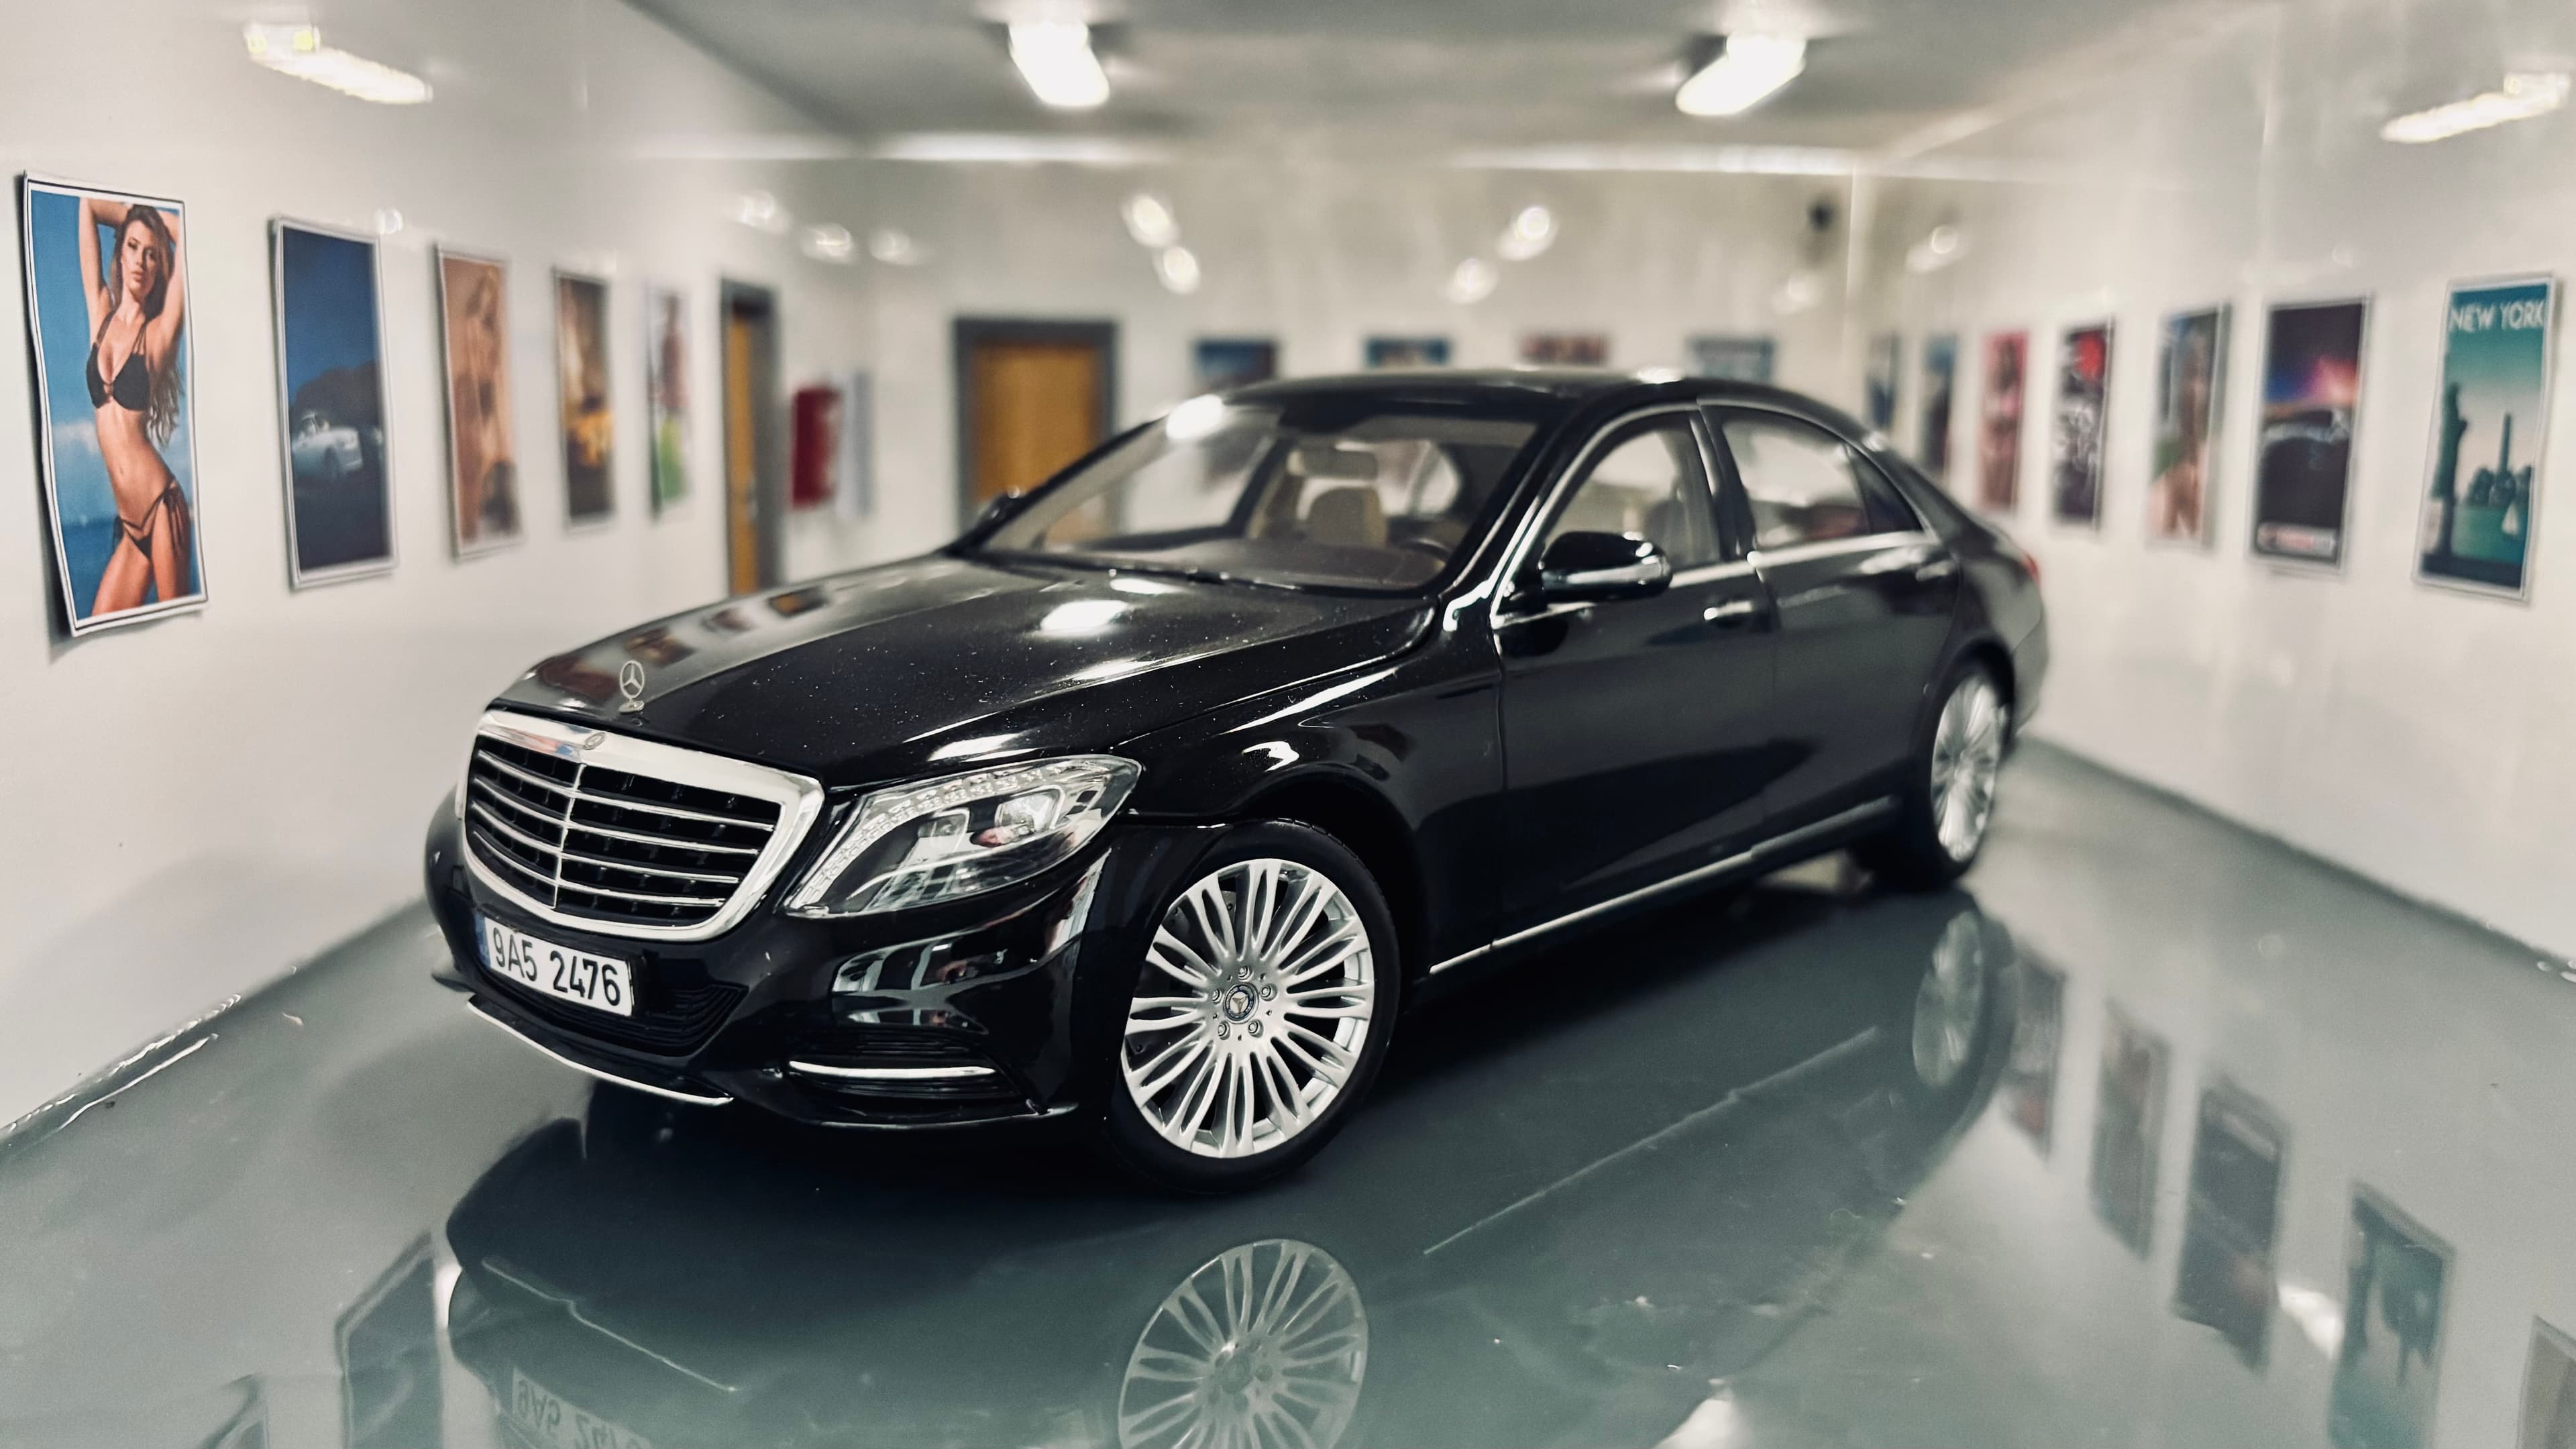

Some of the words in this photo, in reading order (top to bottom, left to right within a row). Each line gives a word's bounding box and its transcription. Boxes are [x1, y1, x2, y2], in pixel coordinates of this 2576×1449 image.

[2449, 303, 2496, 333] NEW
[2500, 299, 2544, 330] YORK
[492, 927, 537, 982] 9A5
[549, 950, 621, 1006] 2476
